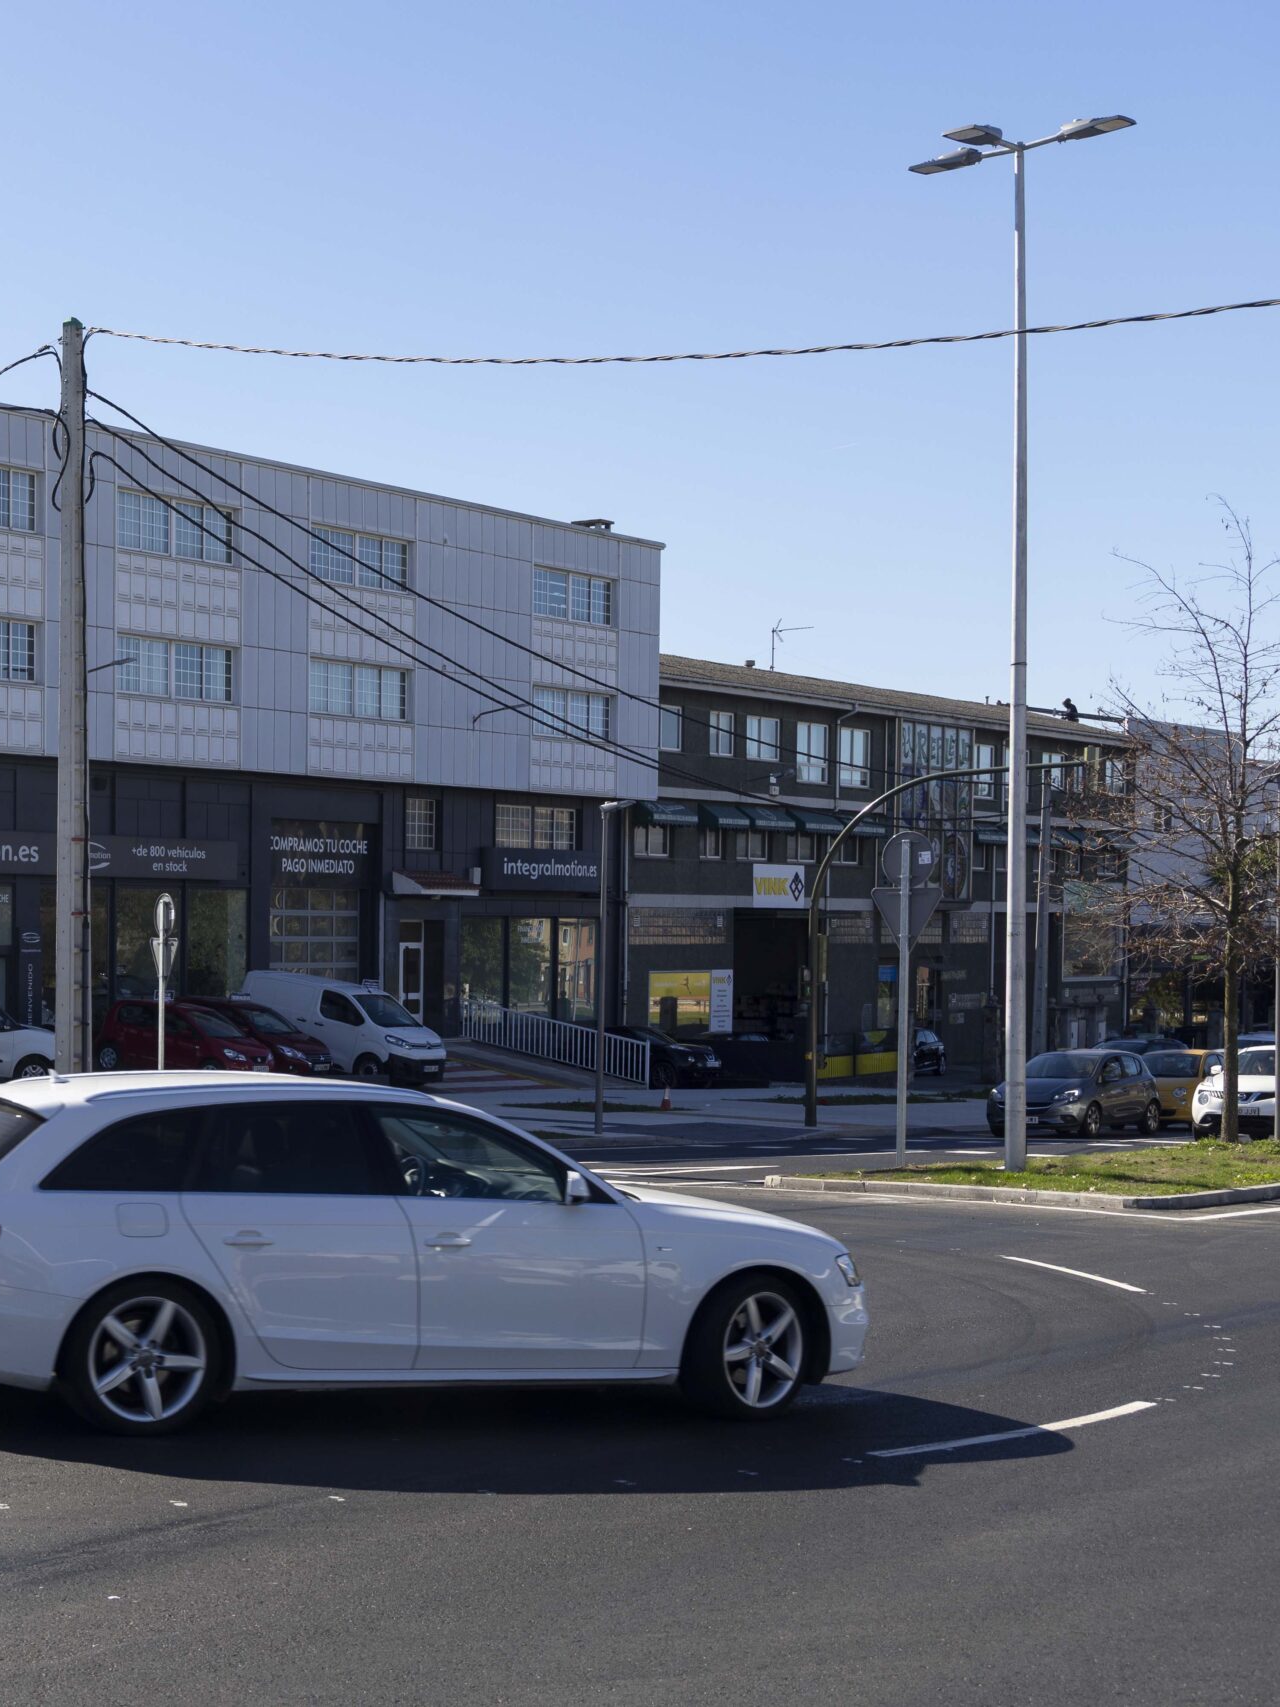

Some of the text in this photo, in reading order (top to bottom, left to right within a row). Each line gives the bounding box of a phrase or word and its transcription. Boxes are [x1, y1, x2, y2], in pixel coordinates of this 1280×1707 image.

[149, 845, 166, 858] 800
[326, 839, 338, 853] TU
[339, 839, 368, 855] COCHE
[152, 860, 188, 873] en stock
[281, 857, 355, 875] PAGO INMEDIATO
[503, 857, 598, 880] integralmotion.es
[753, 876, 789, 897] VINK
